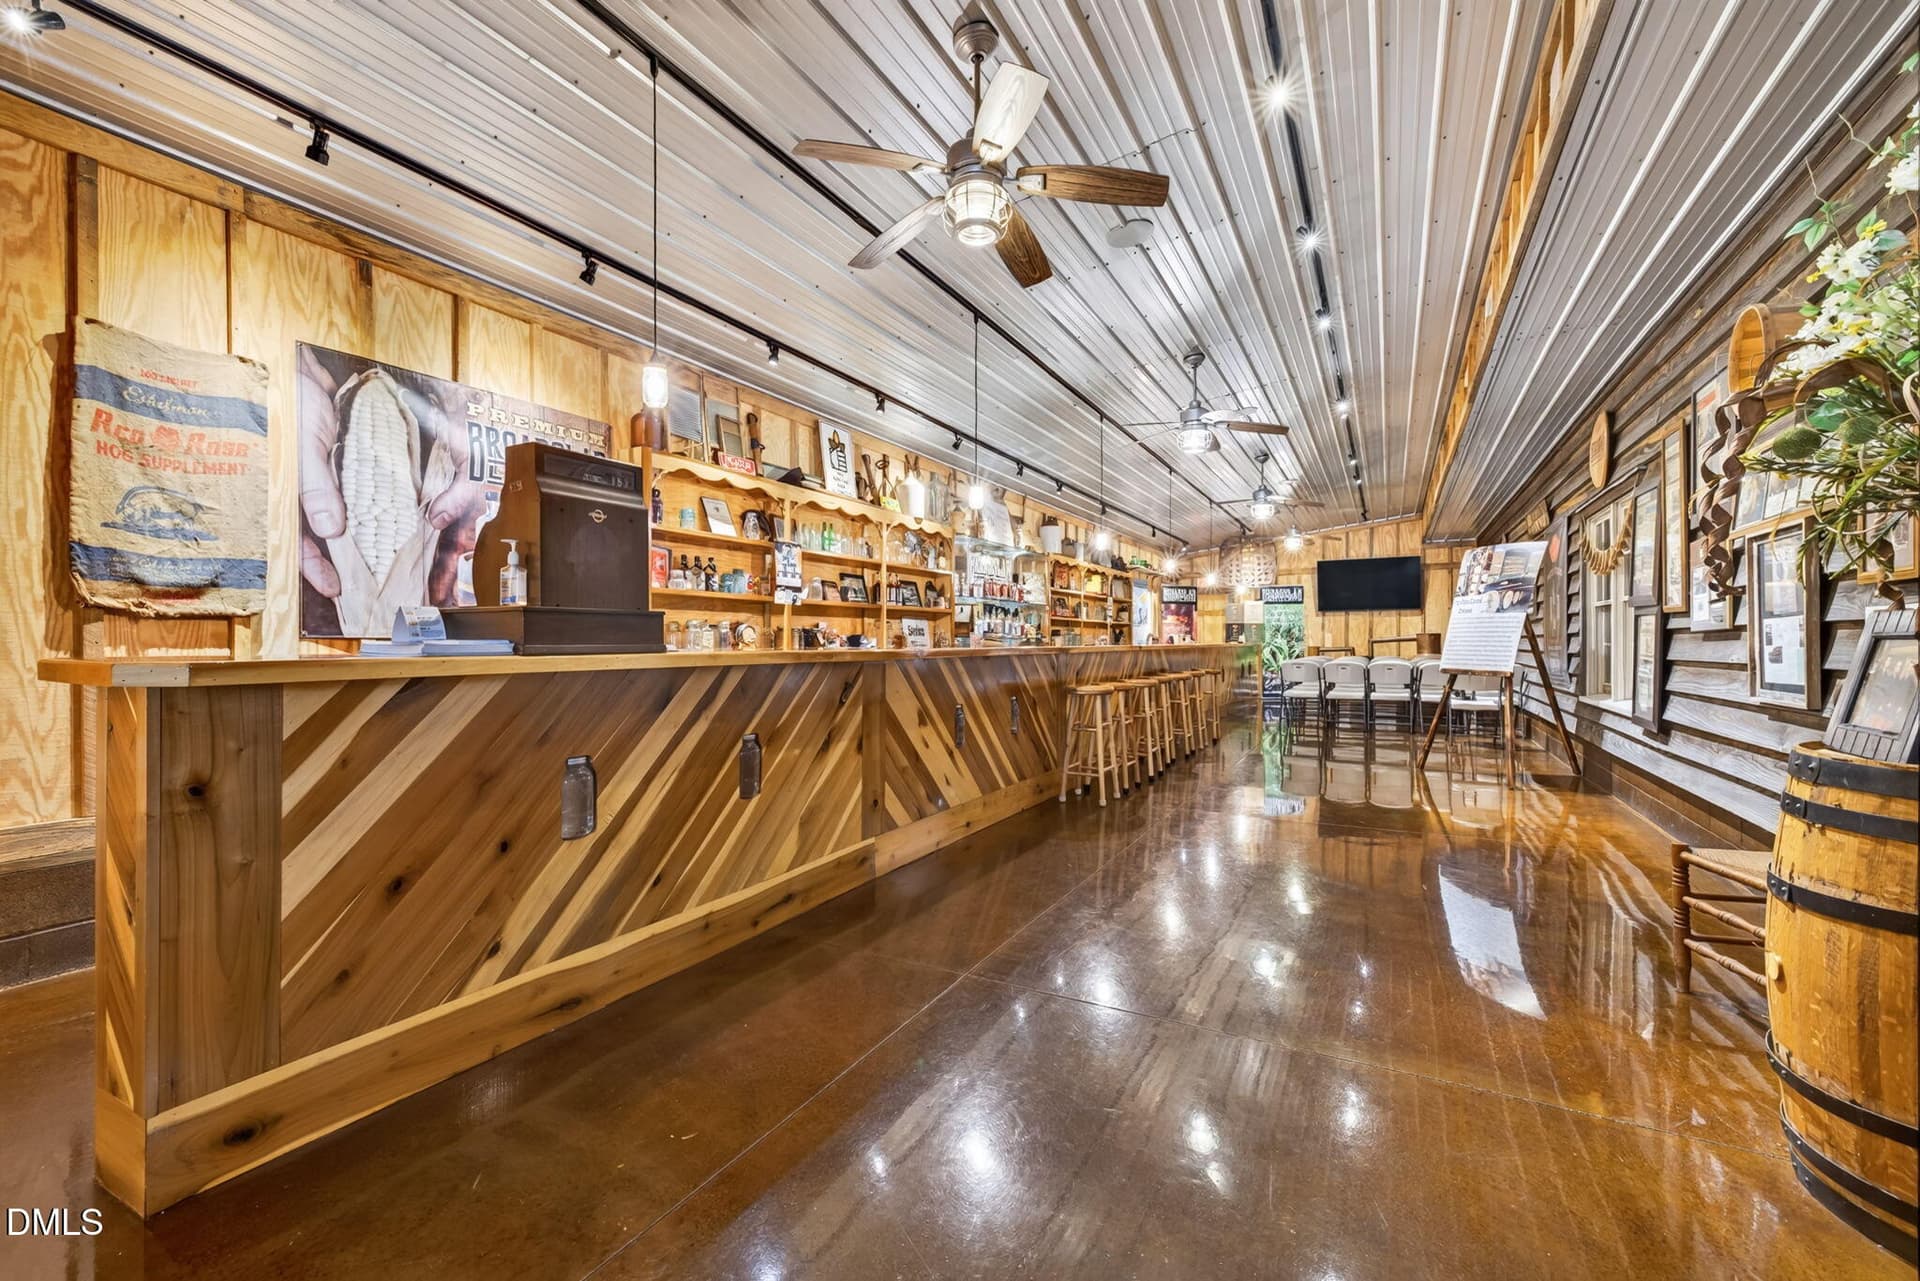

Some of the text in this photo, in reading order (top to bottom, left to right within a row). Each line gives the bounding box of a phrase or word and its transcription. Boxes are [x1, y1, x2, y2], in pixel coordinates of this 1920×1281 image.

[466, 402, 606, 447] PREMIUM
[96, 440, 248, 476] HOG SUPPLEMENT
